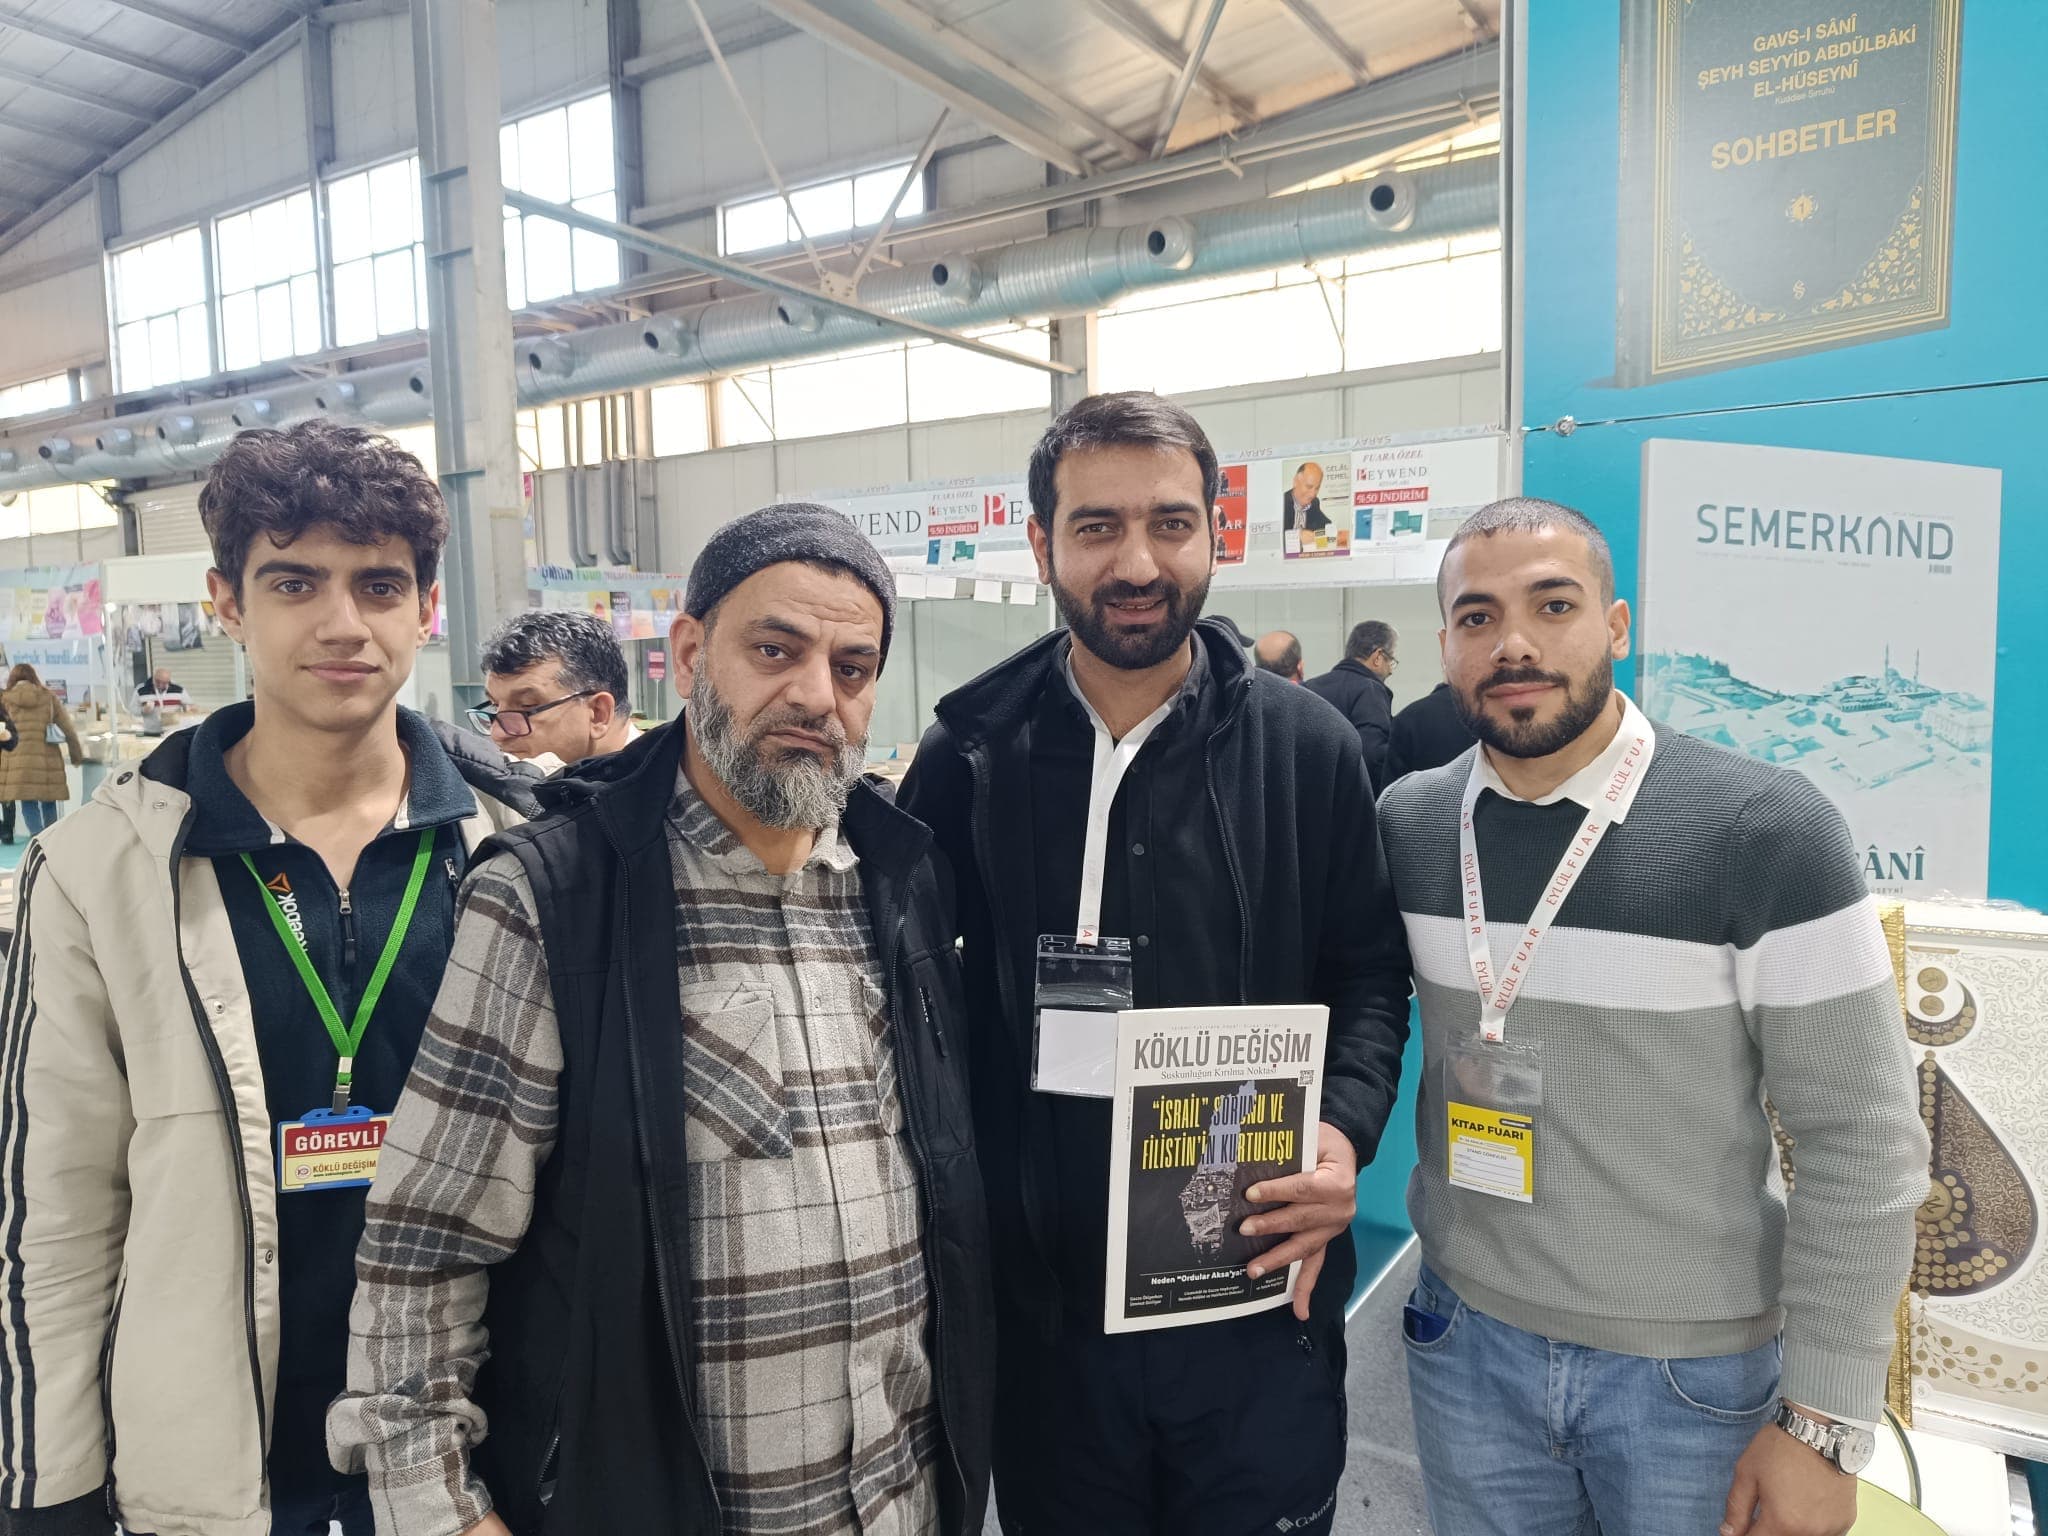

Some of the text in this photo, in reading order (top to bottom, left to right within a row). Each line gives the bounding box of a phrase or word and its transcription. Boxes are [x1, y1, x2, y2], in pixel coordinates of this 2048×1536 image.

[1754, 13, 1857, 51] GAVS-I SÂNÎ
[1698, 24, 1917, 90] ŞEYH SEYYİD ABDÜLBÂKİ
[1754, 59, 1859, 98] EL-HÜSEYNÎ
[1712, 108, 1897, 170] SOHBETLER
[1356, 494, 1377, 504] %50
[1697, 504, 1954, 560] SEMERKAND
[1606, 769, 1631, 802] EYLÜL
[1546, 823, 1600, 906] EYLÜL FUAR
[1855, 844, 1926, 880] ÂNÎ
[1464, 853, 1481, 935] EYLÜL FUAR
[1475, 961, 1493, 997] EYLÜL
[1494, 928, 1540, 1010] EYLÜL FUAR
[1134, 1028, 1312, 1069] KÖKLÜ DEĞİŞİM
[1161, 1066, 1277, 1081] Suskunluğun Kırılma Noktası
[1213, 1094, 1266, 1126] SORUNU
[1270, 1093, 1285, 1123] VE
[295, 1126, 379, 1151] GÖREVLİ
[1220, 1130, 1294, 1166] KURTULUŞU
[1487, 1125, 1524, 1141] FUARI
[313, 1161, 340, 1173] KÖKLÜ
[1151, 1276, 1175, 1285] Neden
